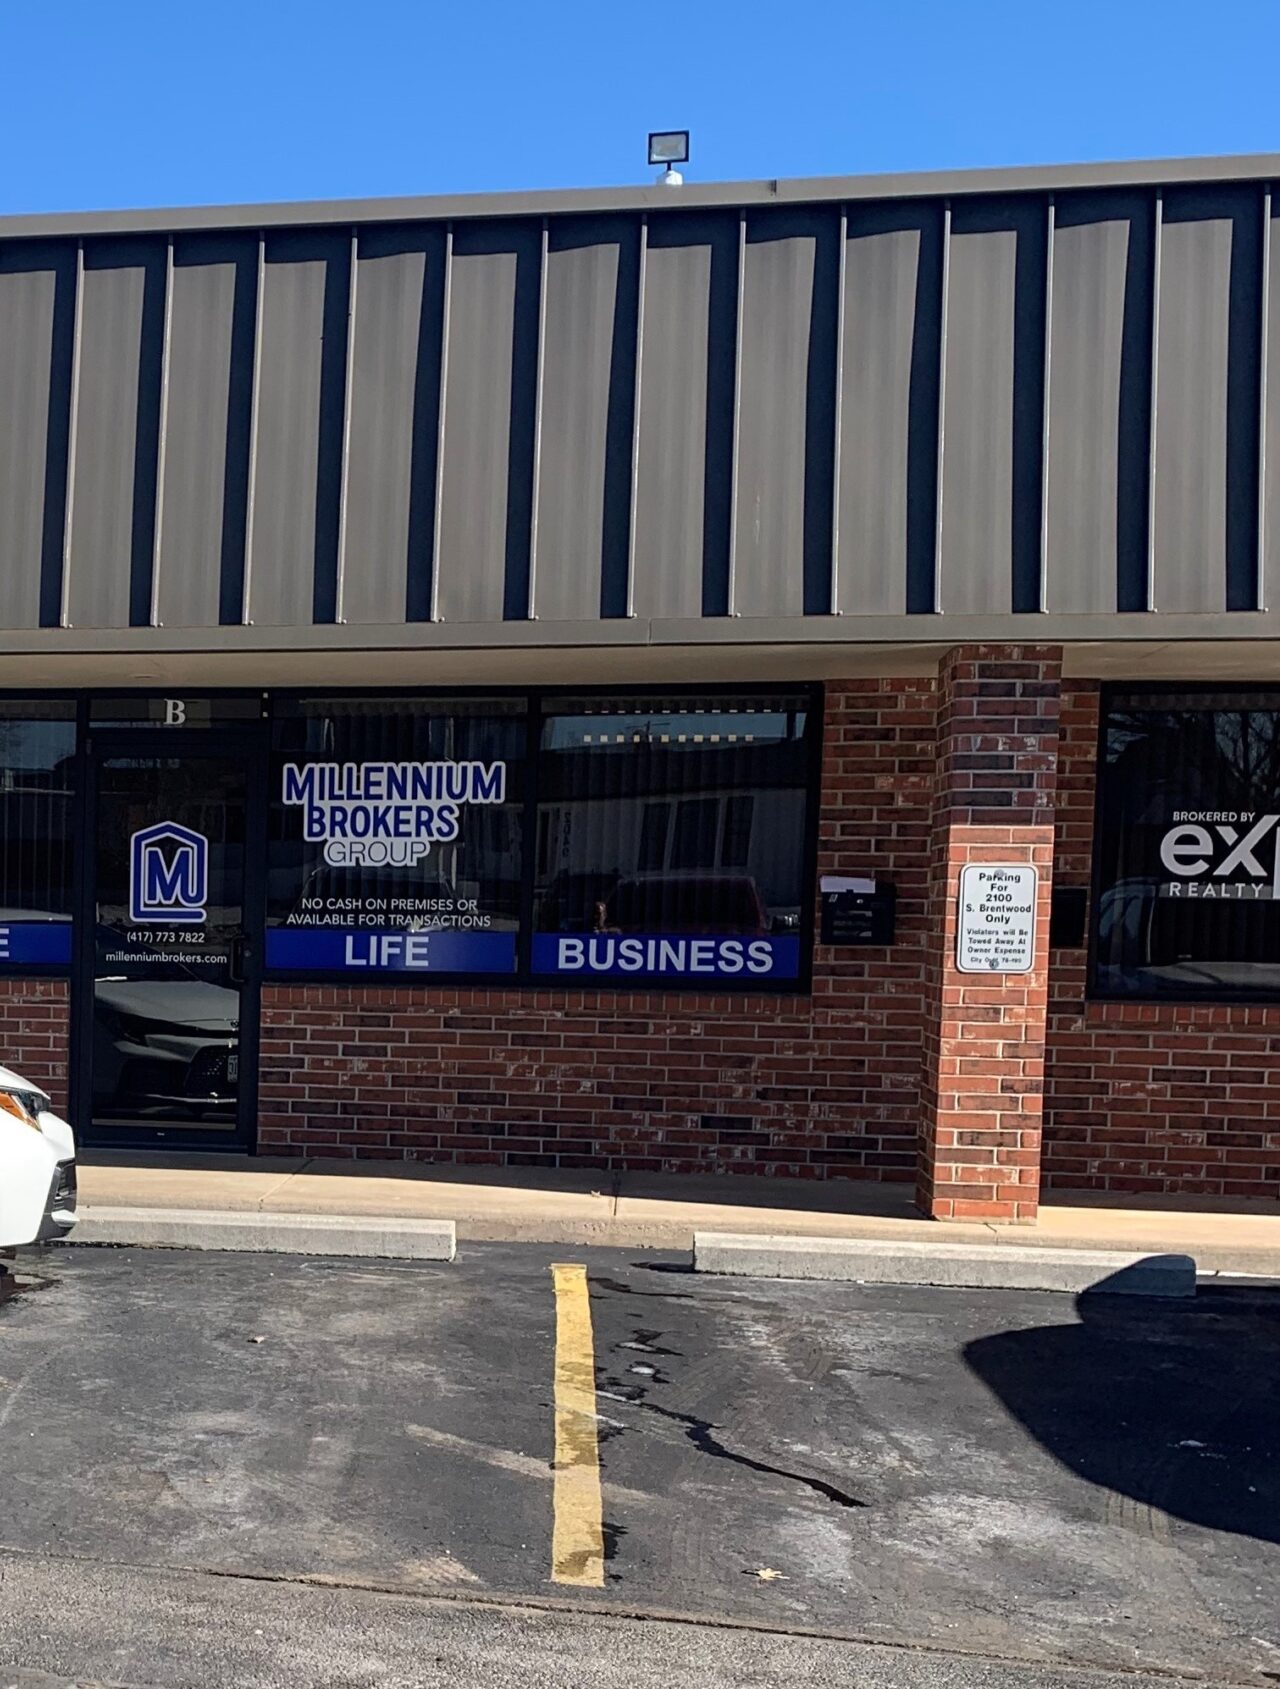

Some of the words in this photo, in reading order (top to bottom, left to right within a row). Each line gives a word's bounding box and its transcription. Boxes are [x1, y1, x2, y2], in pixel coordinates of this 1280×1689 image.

[164, 699, 186, 726] B
[284, 763, 504, 803] MILLENNIUM
[306, 803, 458, 840] BROKERS
[1173, 811, 1238, 822] BROKERED
[1240, 812, 1256, 822] BY
[326, 841, 428, 864] GROUP
[979, 872, 1021, 884] Parking
[990, 883, 1008, 892] For
[1169, 882, 1264, 898] REALTY
[985, 893, 1013, 902] 2100
[301, 898, 323, 910] NO
[326, 898, 362, 910] CASH
[365, 898, 387, 911] ON
[391, 898, 453, 911] PREMISES
[457, 899, 477, 911] OR
[965, 903, 975, 912] S.
[979, 903, 1032, 913] Brentwood
[286, 914, 355, 926] AVAILABLE
[358, 914, 385, 926] FOR
[388, 914, 491, 927] TRANSACTIONS
[985, 914, 1011, 925] Only
[126, 931, 153, 943] (417)
[155, 931, 176, 943] 773
[178, 932, 205, 943] 7822
[967, 928, 999, 936] Violators
[968, 937, 992, 945] Towed
[995, 938, 1014, 946] Away
[105, 950, 228, 963] millenniumbrokers.com
[345, 935, 429, 967] LIFE
[557, 938, 774, 974] BUSINESS
[994, 946, 1026, 955] Expense
